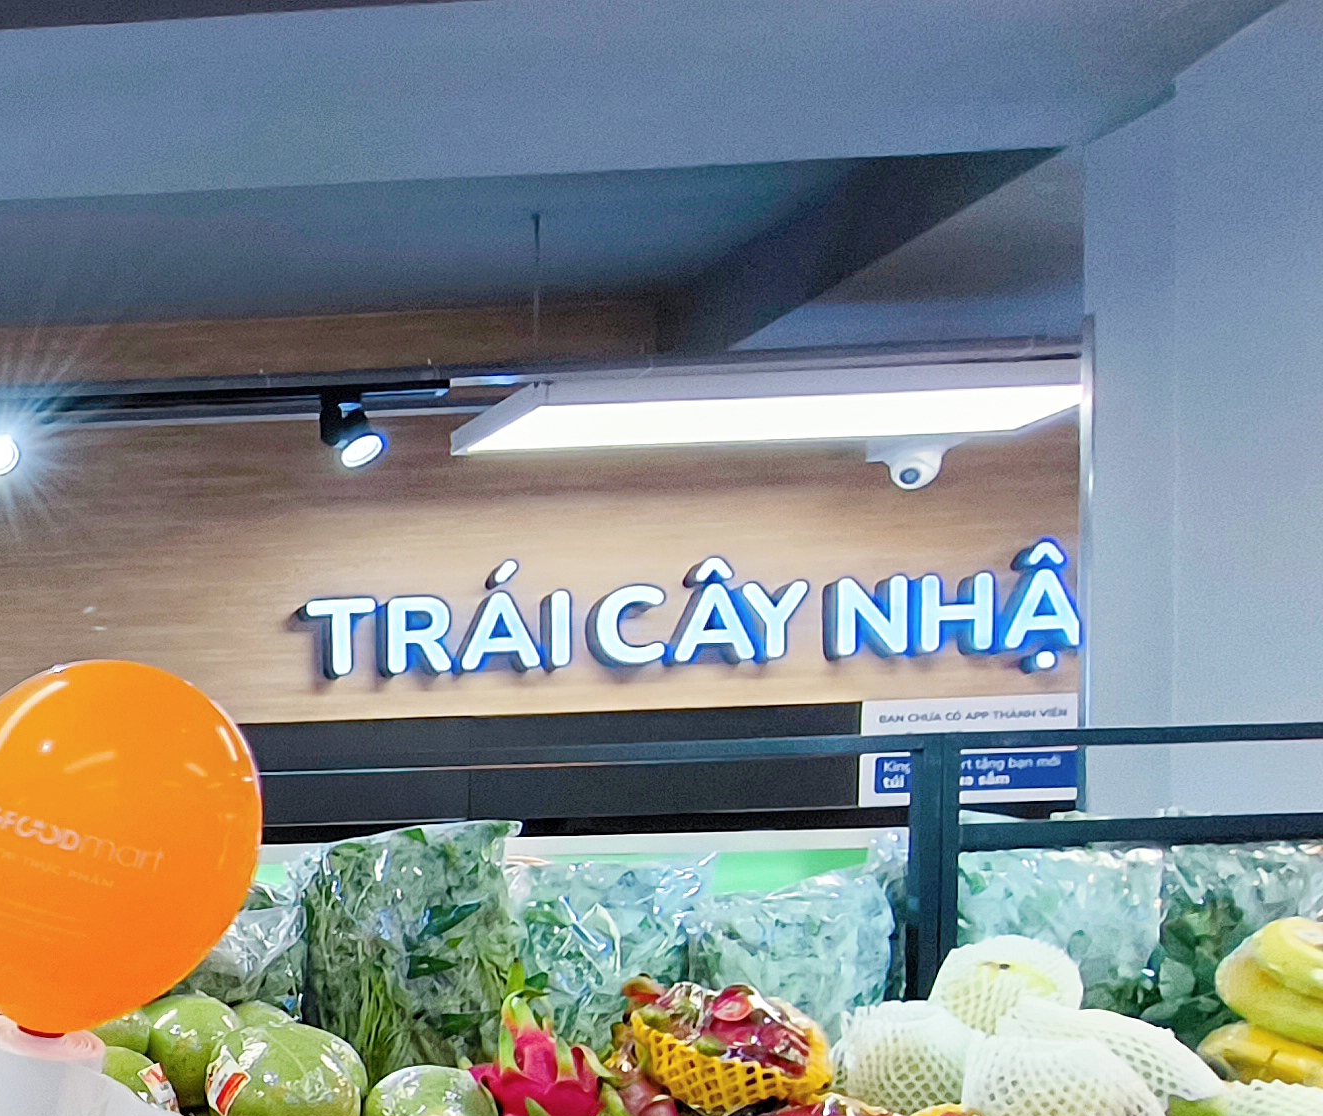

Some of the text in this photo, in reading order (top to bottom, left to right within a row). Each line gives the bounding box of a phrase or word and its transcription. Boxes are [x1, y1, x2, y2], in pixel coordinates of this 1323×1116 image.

[303, 538, 1081, 679] TRÁI CÂY NHẬ
[965, 711, 989, 720] APP
